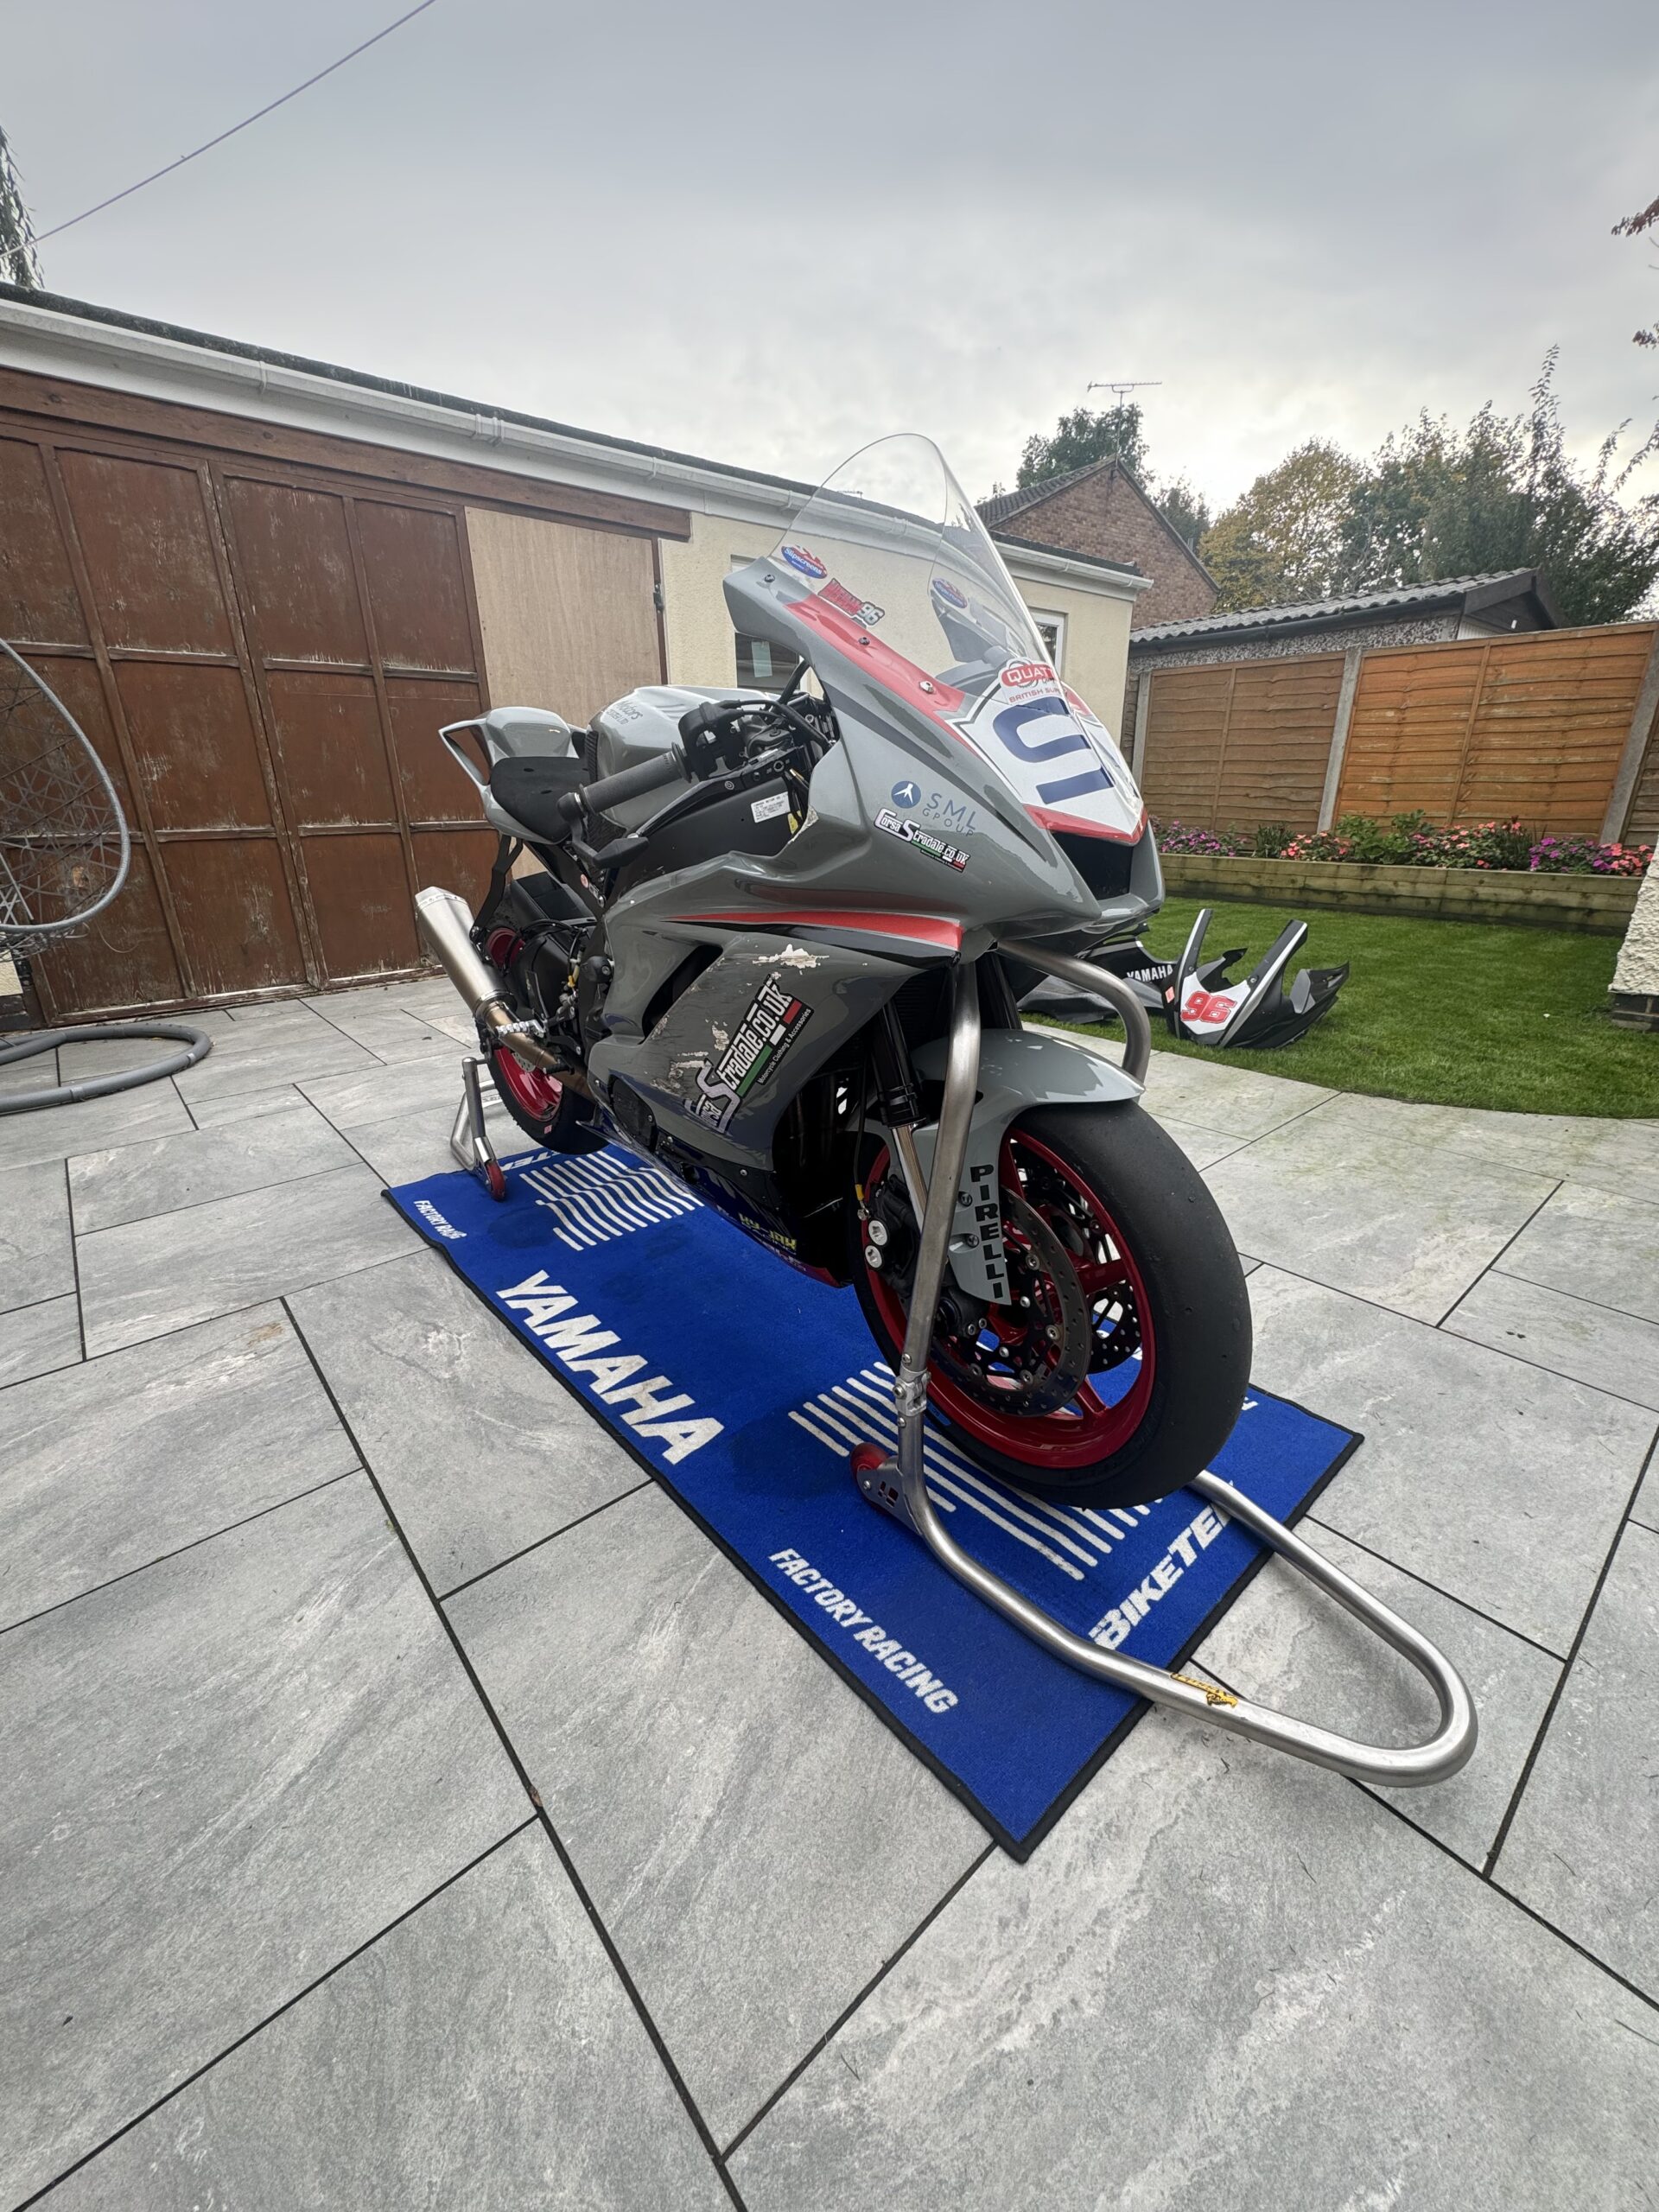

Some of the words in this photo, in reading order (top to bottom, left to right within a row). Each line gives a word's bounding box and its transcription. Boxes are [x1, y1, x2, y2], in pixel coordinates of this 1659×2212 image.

[926, 793, 976, 830] SML
[1127, 964, 1173, 982] YAMAHA
[788, 1009, 812, 1039] Accessories
[1180, 990, 1237, 1024] 96
[413, 1200, 449, 1225] FACTORY
[969, 1164, 1005, 1299] PIRELLI
[495, 1269, 725, 1465] YAMAHA
[768, 1548, 874, 1628] FACTORY
[854, 1625, 959, 1713] RACING
